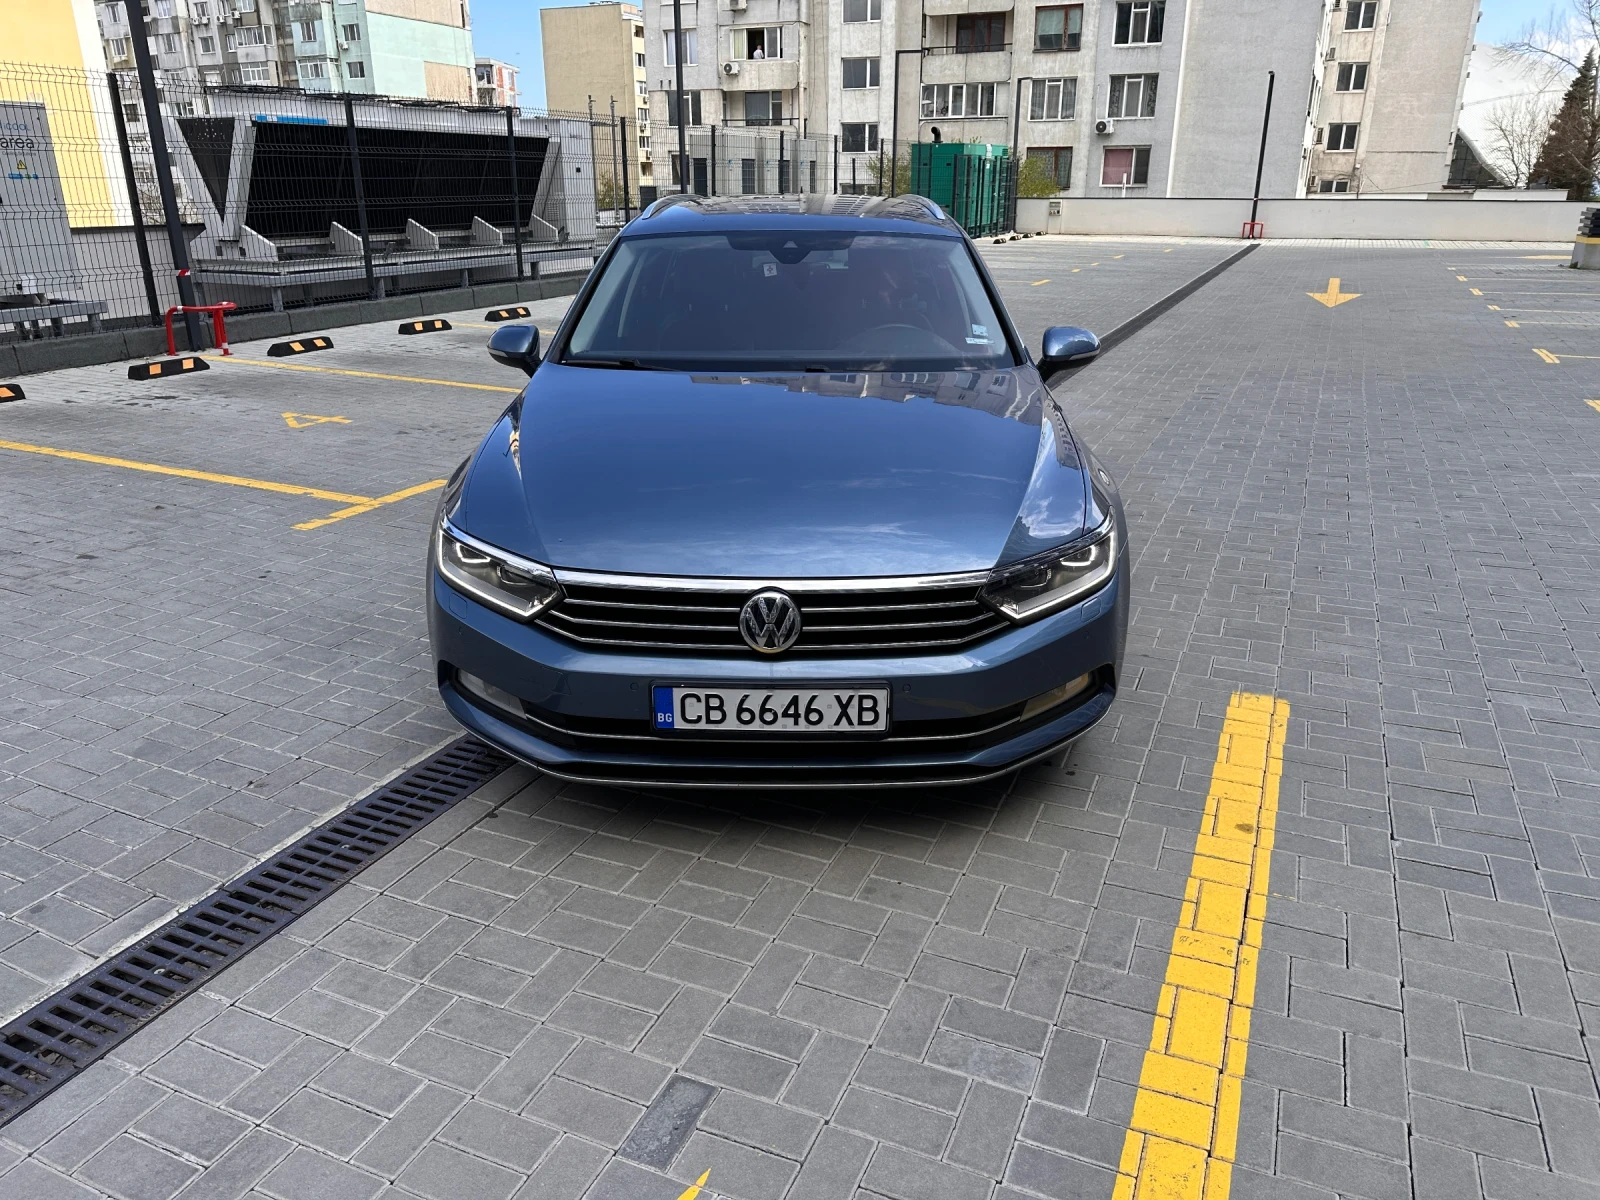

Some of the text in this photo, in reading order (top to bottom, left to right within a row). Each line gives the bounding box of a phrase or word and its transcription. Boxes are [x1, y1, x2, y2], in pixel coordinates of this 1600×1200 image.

[0, 137, 34, 149] area
[680, 693, 880, 726] CB 6646 XB
[657, 712, 673, 723] BG
